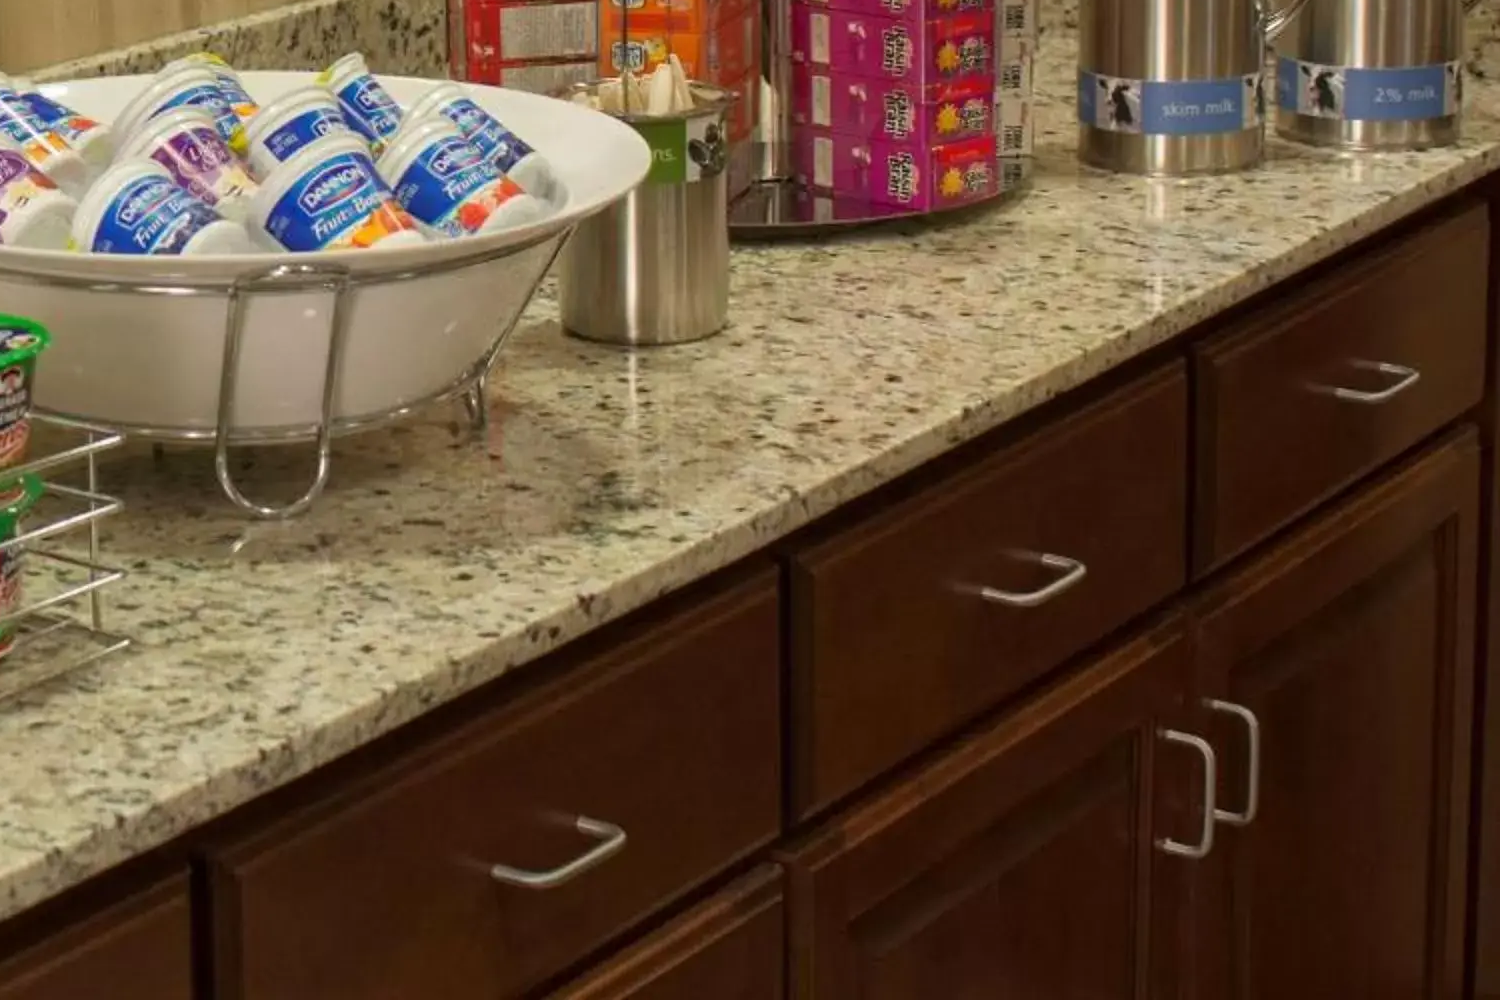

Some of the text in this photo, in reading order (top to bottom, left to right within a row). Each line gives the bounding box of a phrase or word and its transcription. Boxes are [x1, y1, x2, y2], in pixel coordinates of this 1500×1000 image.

[892, 26, 906, 76] Raisin
[894, 91, 907, 138] Raisin
[1161, 101, 1200, 118] skim
[1374, 86, 1403, 103] 2%
[303, 162, 365, 209] DANNON
[898, 153, 912, 202] Raisin
[133, 213, 166, 249] Fruit
[311, 212, 344, 242] Fruit
